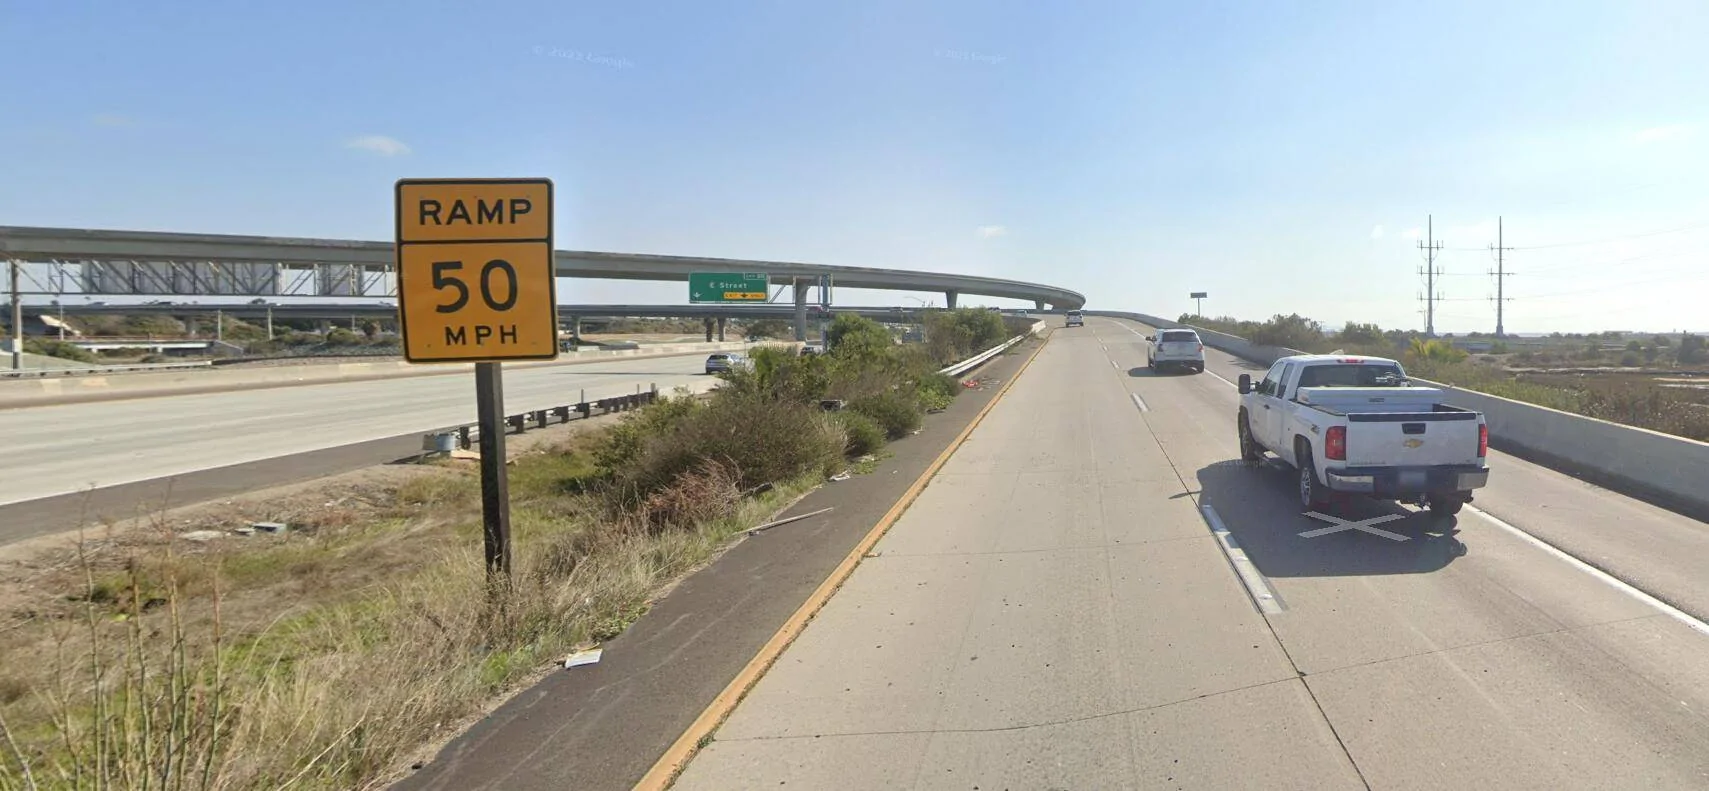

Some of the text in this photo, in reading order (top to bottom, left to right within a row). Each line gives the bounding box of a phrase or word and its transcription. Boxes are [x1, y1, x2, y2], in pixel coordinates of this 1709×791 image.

[419, 199, 532, 225] RAMP
[432, 259, 518, 313] 50
[445, 325, 517, 346] MPH
